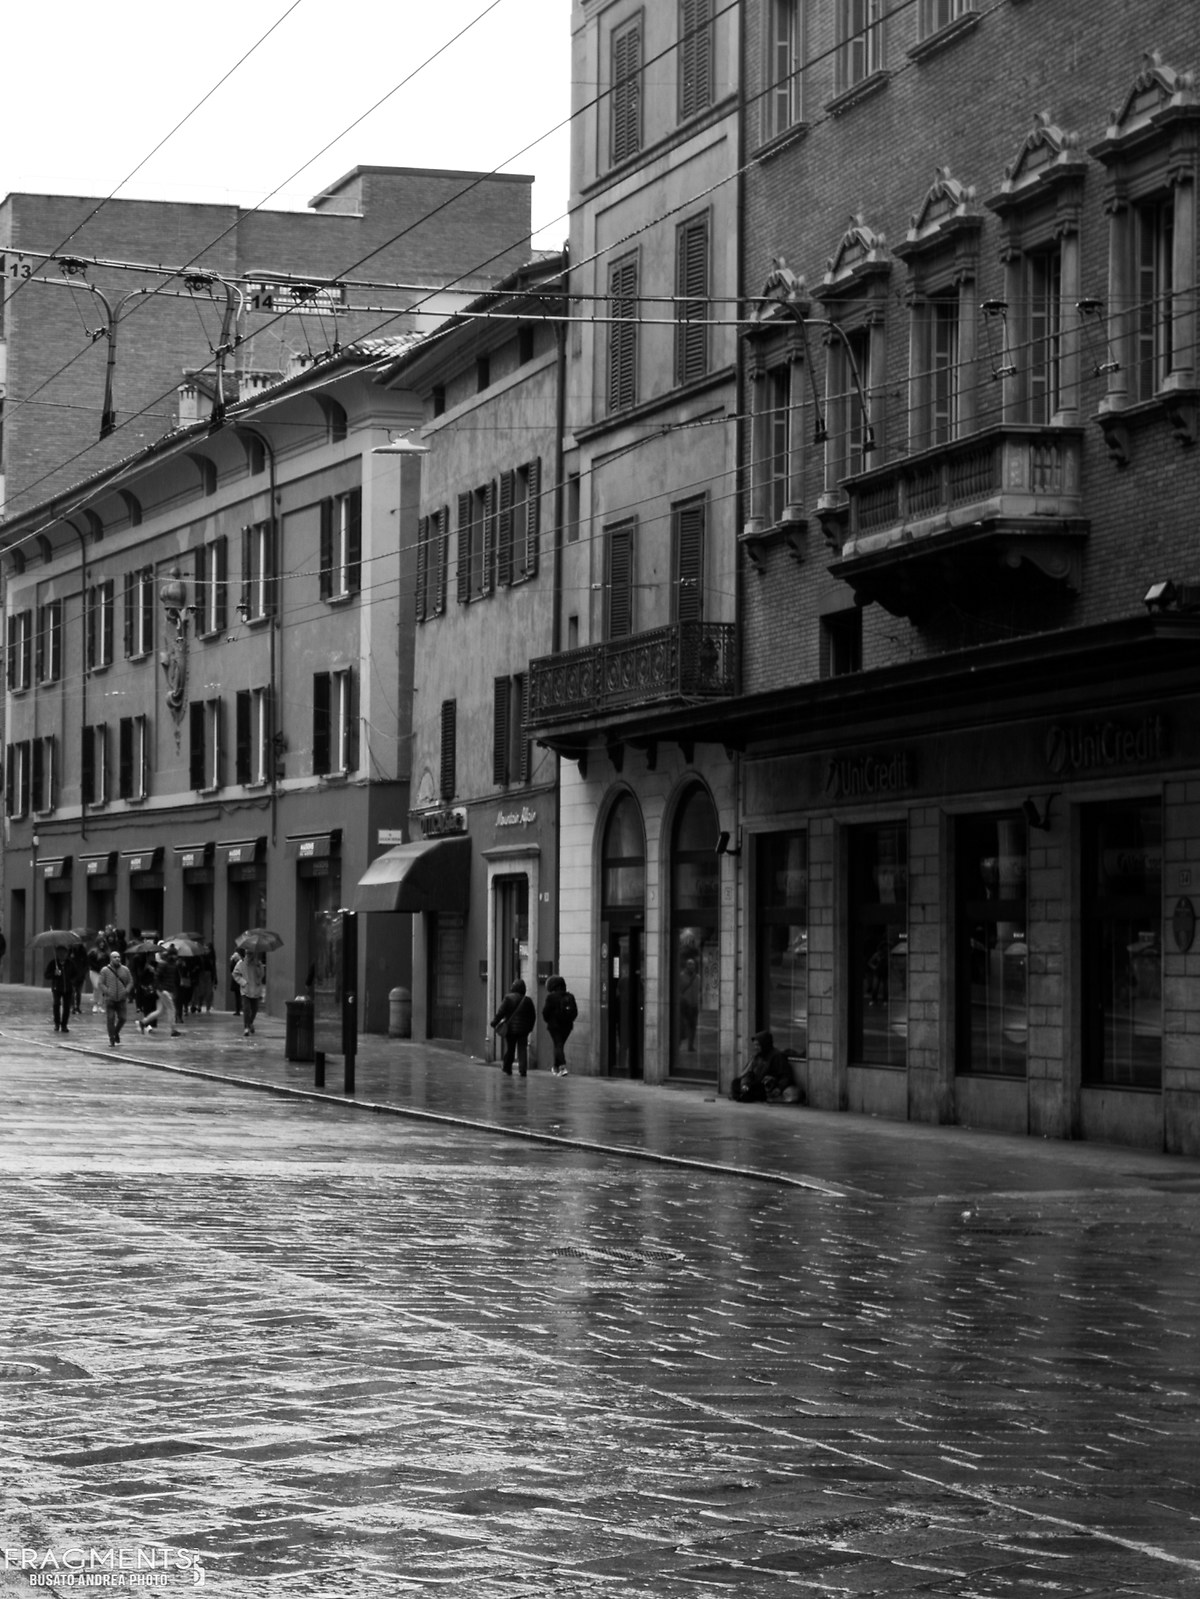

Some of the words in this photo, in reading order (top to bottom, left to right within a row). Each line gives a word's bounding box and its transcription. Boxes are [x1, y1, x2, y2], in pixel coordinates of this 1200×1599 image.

[10, 263, 32, 279] 13
[252, 295, 273, 309] 14
[1069, 714, 1163, 768] UniCredit
[841, 751, 909, 796] UniCredit
